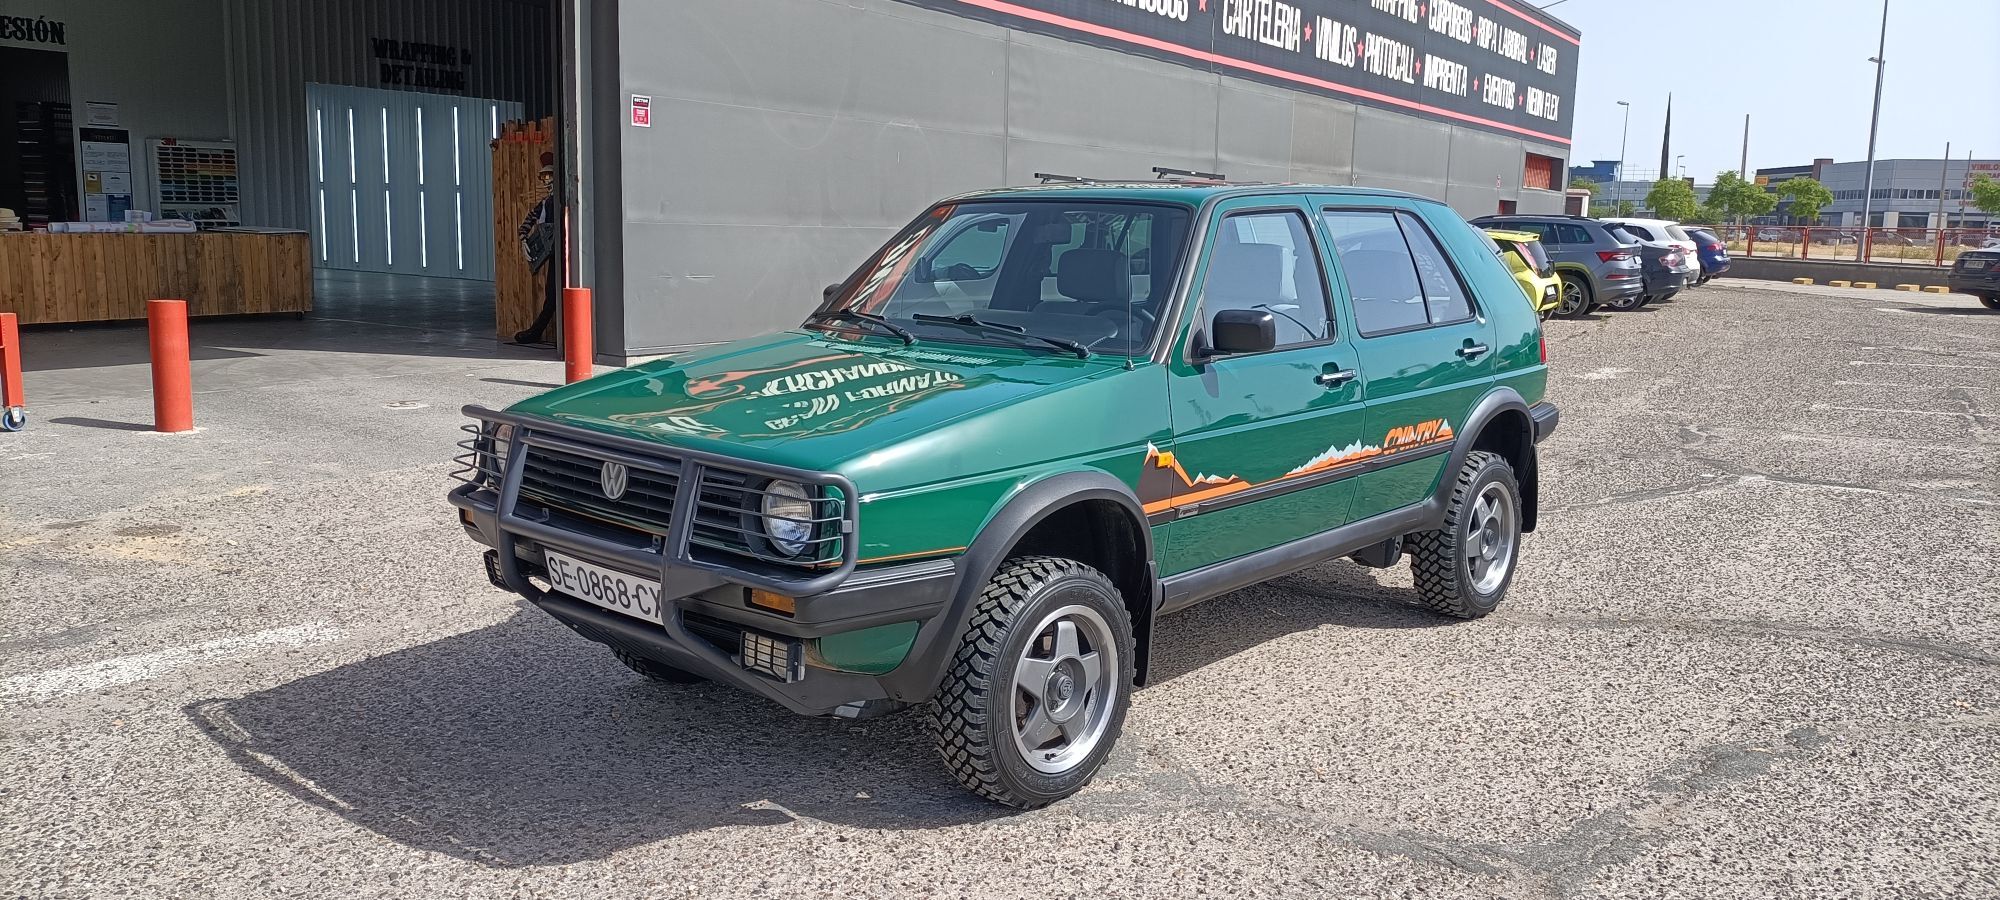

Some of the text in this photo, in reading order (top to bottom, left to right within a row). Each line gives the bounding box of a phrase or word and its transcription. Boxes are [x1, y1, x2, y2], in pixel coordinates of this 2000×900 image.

[0, 15, 66, 45] ESIÓN
[371, 38, 457, 66] WRAPPING
[1223, 0, 1301, 53] CARTELERIA
[1316, 15, 1357, 68] VINILOS
[1363, 31, 1415, 84] PHOTOCALL
[1424, 53, 1468, 97] IMPRENTA
[1483, 73, 1516, 110] EVENTOS
[1543, 92, 1560, 122] FLEX
[1477, 16, 1498, 53] ROPA
[1498, 25, 1528, 65] LABORAL
[1537, 42, 1557, 76] LASER
[380, 63, 465, 90] DETAILING
[161, 137, 177, 146] 3M
[1383, 418, 1443, 448] COUNTRY
